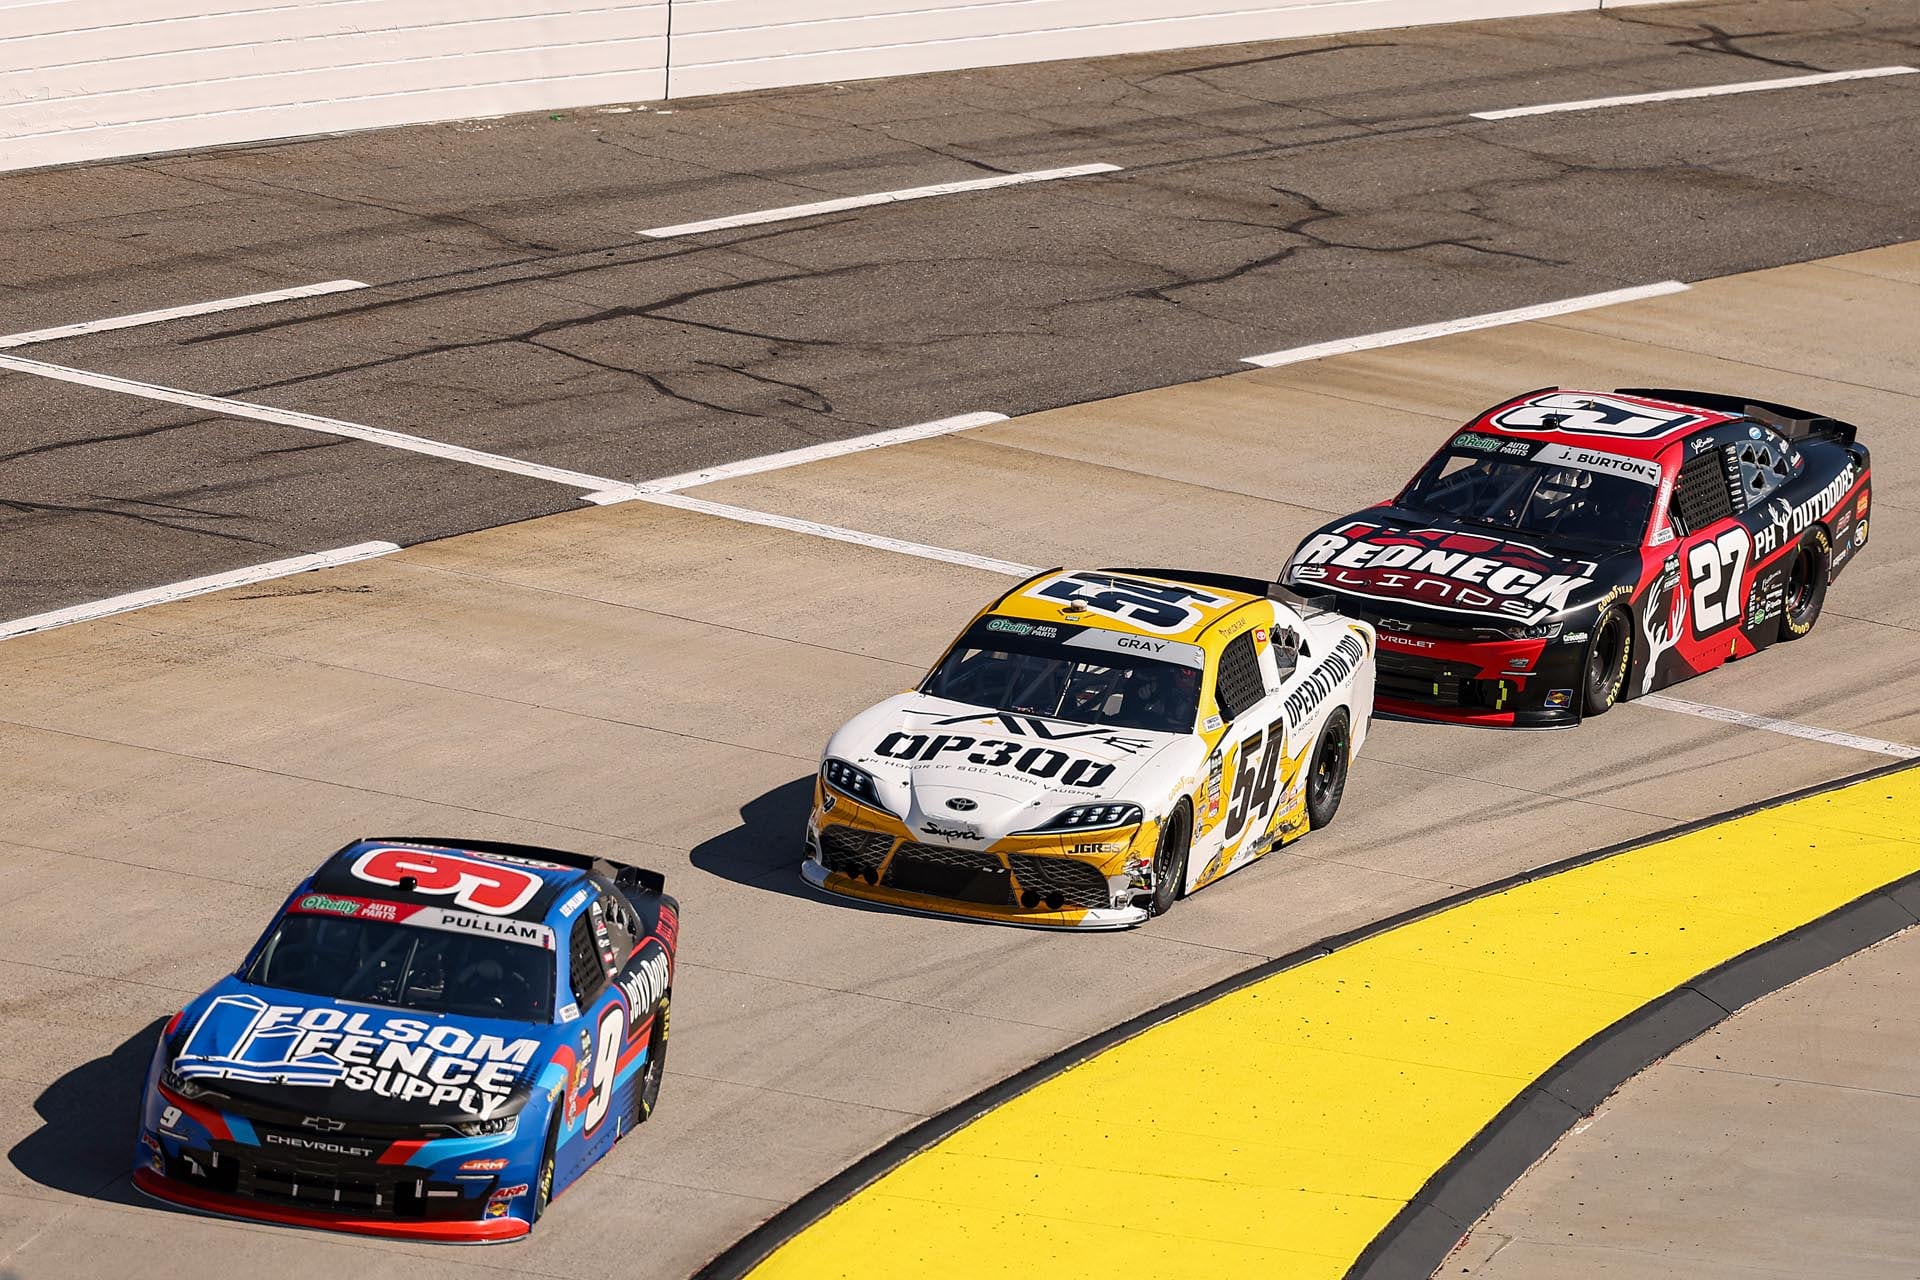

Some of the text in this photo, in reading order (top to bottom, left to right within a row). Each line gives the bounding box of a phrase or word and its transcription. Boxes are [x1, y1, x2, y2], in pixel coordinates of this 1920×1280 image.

[1452, 434, 1530, 451] O'Reilly AUTO
[1499, 446, 1529, 457] PARTS
[1558, 451, 1646, 475] J. BURTON
[1754, 524, 1777, 560] PH
[1793, 463, 1854, 534] OUTDOORS
[1296, 533, 1594, 613] REDNECK
[1689, 527, 1750, 632] 27
[1294, 565, 1537, 616] BLINDS
[1598, 585, 1633, 613] GOODYEAR
[1031, 630, 1057, 639] PARTS
[1037, 625, 1058, 633] AUTO
[1376, 633, 1435, 649] EVROLET
[1117, 637, 1166, 653] GRAY
[1283, 652, 1350, 729] OPERATION
[1335, 634, 1364, 668] 300
[873, 731, 1117, 788] OP300
[993, 771, 1038, 787] AARON
[1043, 783, 1095, 797] VAUGHN
[1225, 716, 1284, 840] 54
[920, 821, 985, 843] Supra
[301, 895, 397, 915] O'Reilly AUTO
[361, 908, 397, 921] PARTS
[442, 915, 538, 939] PULLIAM
[255, 1005, 541, 1065] FOLSOM
[294, 1032, 524, 1095] FENCE
[585, 1008, 624, 1131] 9
[344, 1065, 508, 1120] SUPPLY
[159, 1105, 183, 1129] 9
[266, 1134, 374, 1157] CHEVROLET
